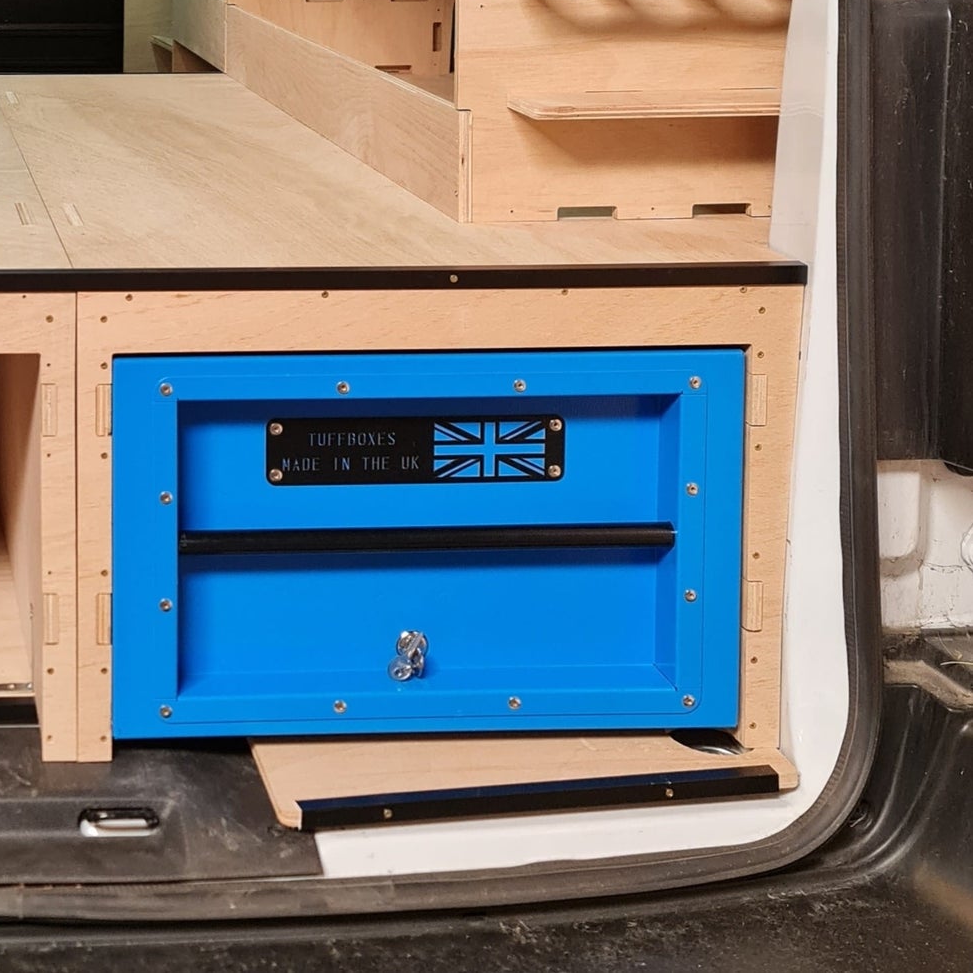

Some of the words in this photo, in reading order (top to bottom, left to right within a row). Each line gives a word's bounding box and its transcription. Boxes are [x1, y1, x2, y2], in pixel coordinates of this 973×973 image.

[308, 432, 396, 447] TUFFBOXES
[282, 457, 320, 472] MADE
[334, 457, 350, 471] IN
[362, 456, 390, 470] THE
[401, 455, 420, 470] UK
